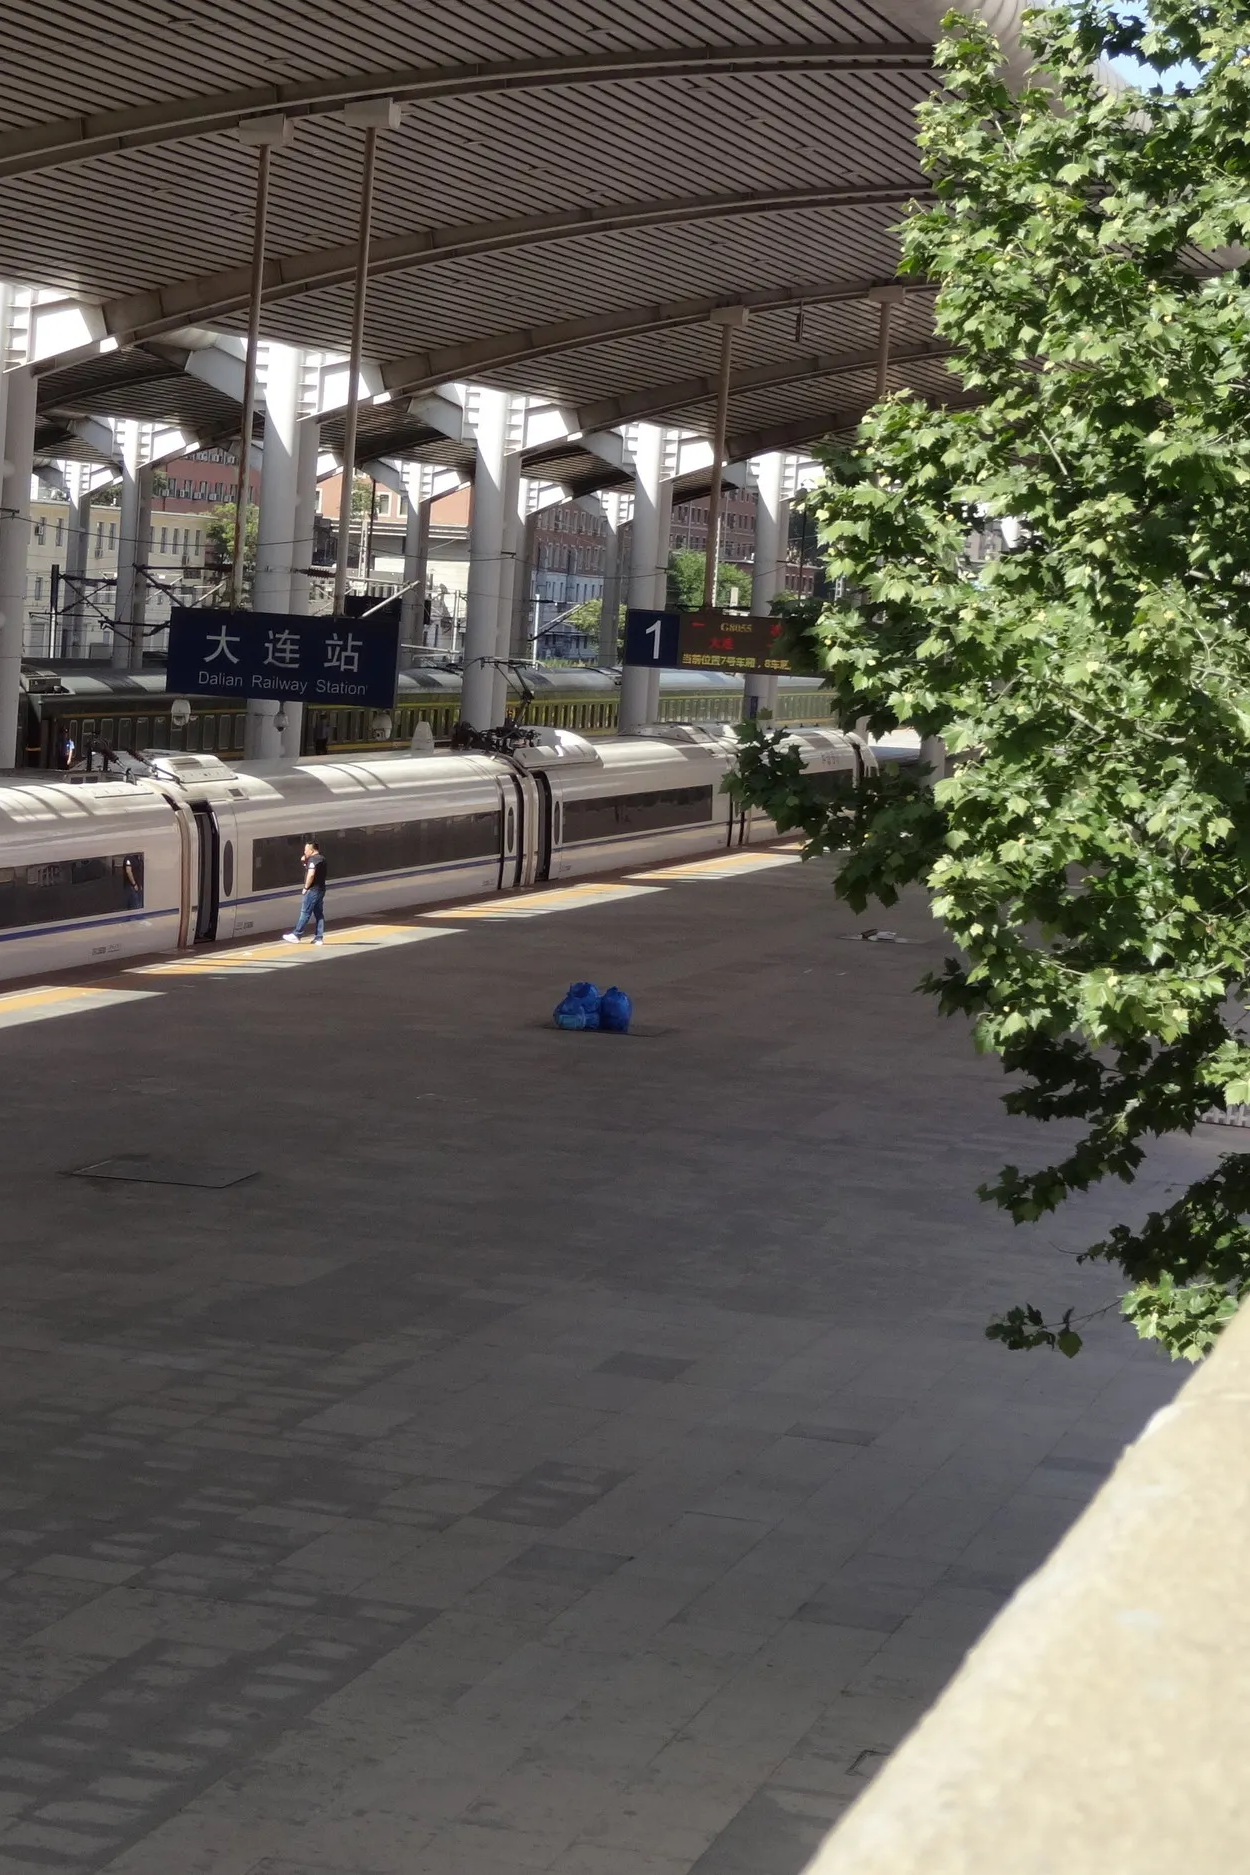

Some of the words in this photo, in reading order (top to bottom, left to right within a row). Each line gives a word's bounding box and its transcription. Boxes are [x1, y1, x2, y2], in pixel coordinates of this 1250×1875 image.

[645, 619, 662, 660] 1
[720, 622, 753, 633] G8055
[202, 624, 364, 673] 大连站
[198, 671, 243, 687] Dalian
[251, 675, 308, 695] Railway
[316, 679, 366, 696] Station
